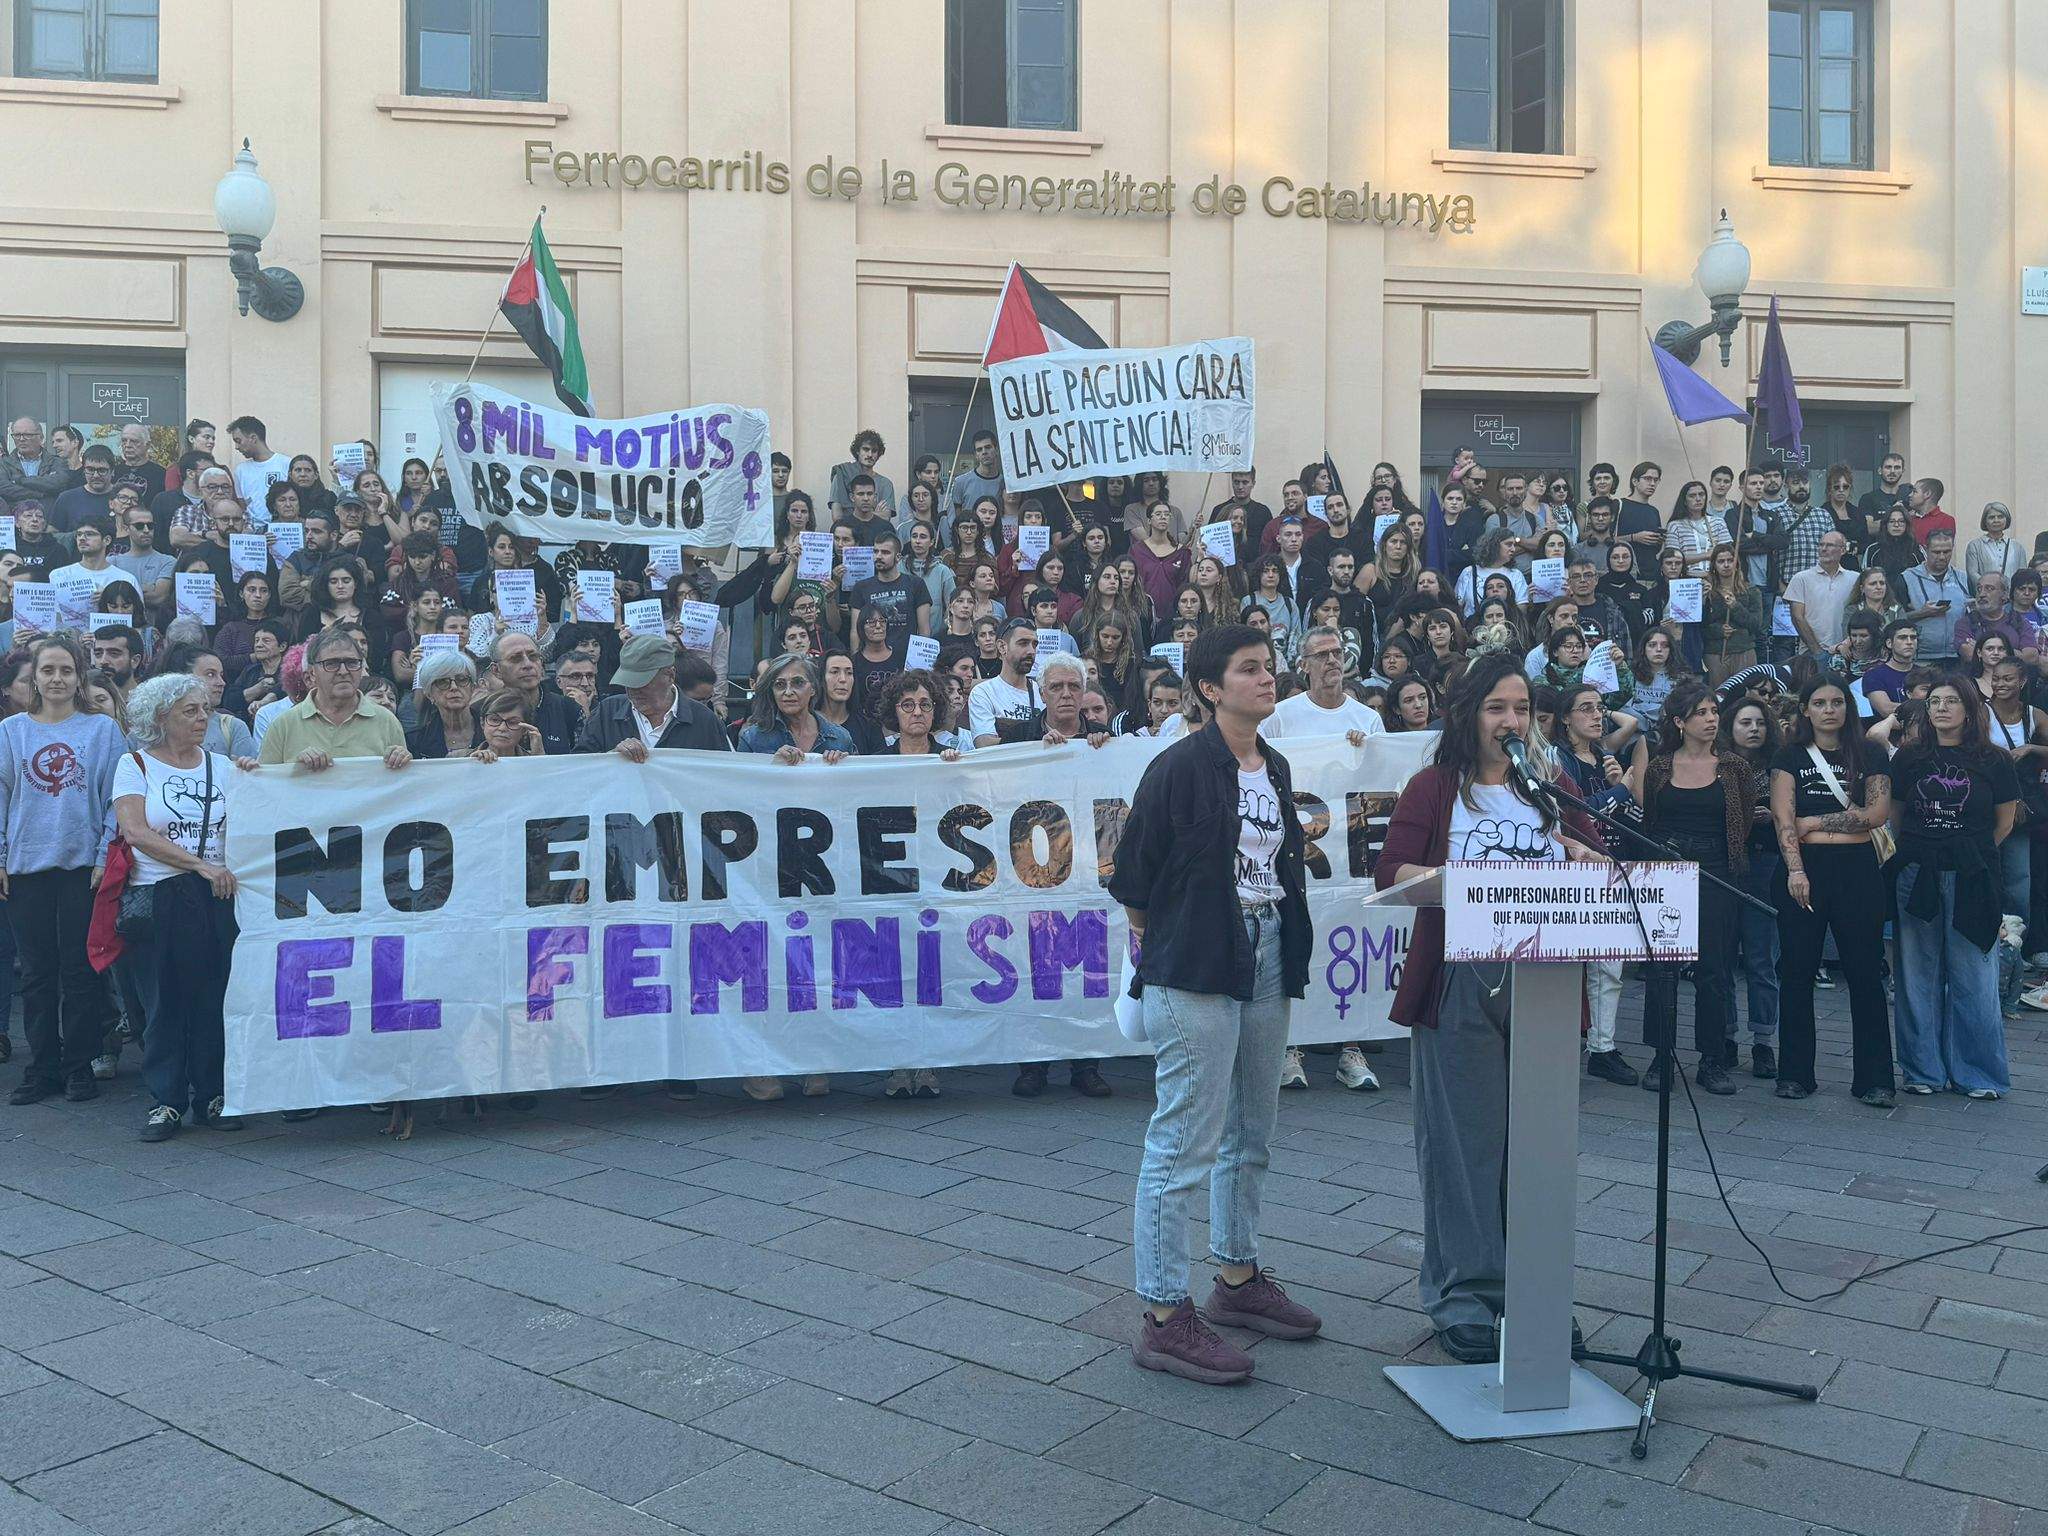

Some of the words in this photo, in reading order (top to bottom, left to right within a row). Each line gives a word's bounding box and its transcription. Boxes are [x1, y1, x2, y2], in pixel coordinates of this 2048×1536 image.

[524, 140, 790, 194] Ferrocarrils
[806, 154, 863, 199] de
[881, 158, 918, 202] la
[934, 162, 1175, 212] Generalitat
[1193, 174, 1246, 215] de
[1261, 176, 1476, 233] Catalunya
[98, 388, 123, 398] CAFÉ
[1000, 369, 1059, 421] QUE
[1175, 352, 1246, 401] CARA
[119, 402, 143, 412] CAFÉ
[453, 397, 476, 454] 8
[1478, 418, 1500, 428] CAFÉ
[1495, 432, 1515, 442] CAFÉ
[1009, 428, 1044, 480] LA
[441, 516, 462, 525] EACE
[274, 820, 454, 920] NO
[1467, 887, 1483, 904] NO
[1487, 887, 1580, 904] EMPRESONAREU
[1584, 887, 1597, 904] EL
[1600, 887, 1664, 904] FEMINISME
[1493, 911, 1512, 926] QUE
[1514, 911, 1549, 925] PAGUIN
[1552, 911, 1577, 925] CARA
[1579, 911, 1590, 925] LA
[275, 935, 442, 1041] EL
